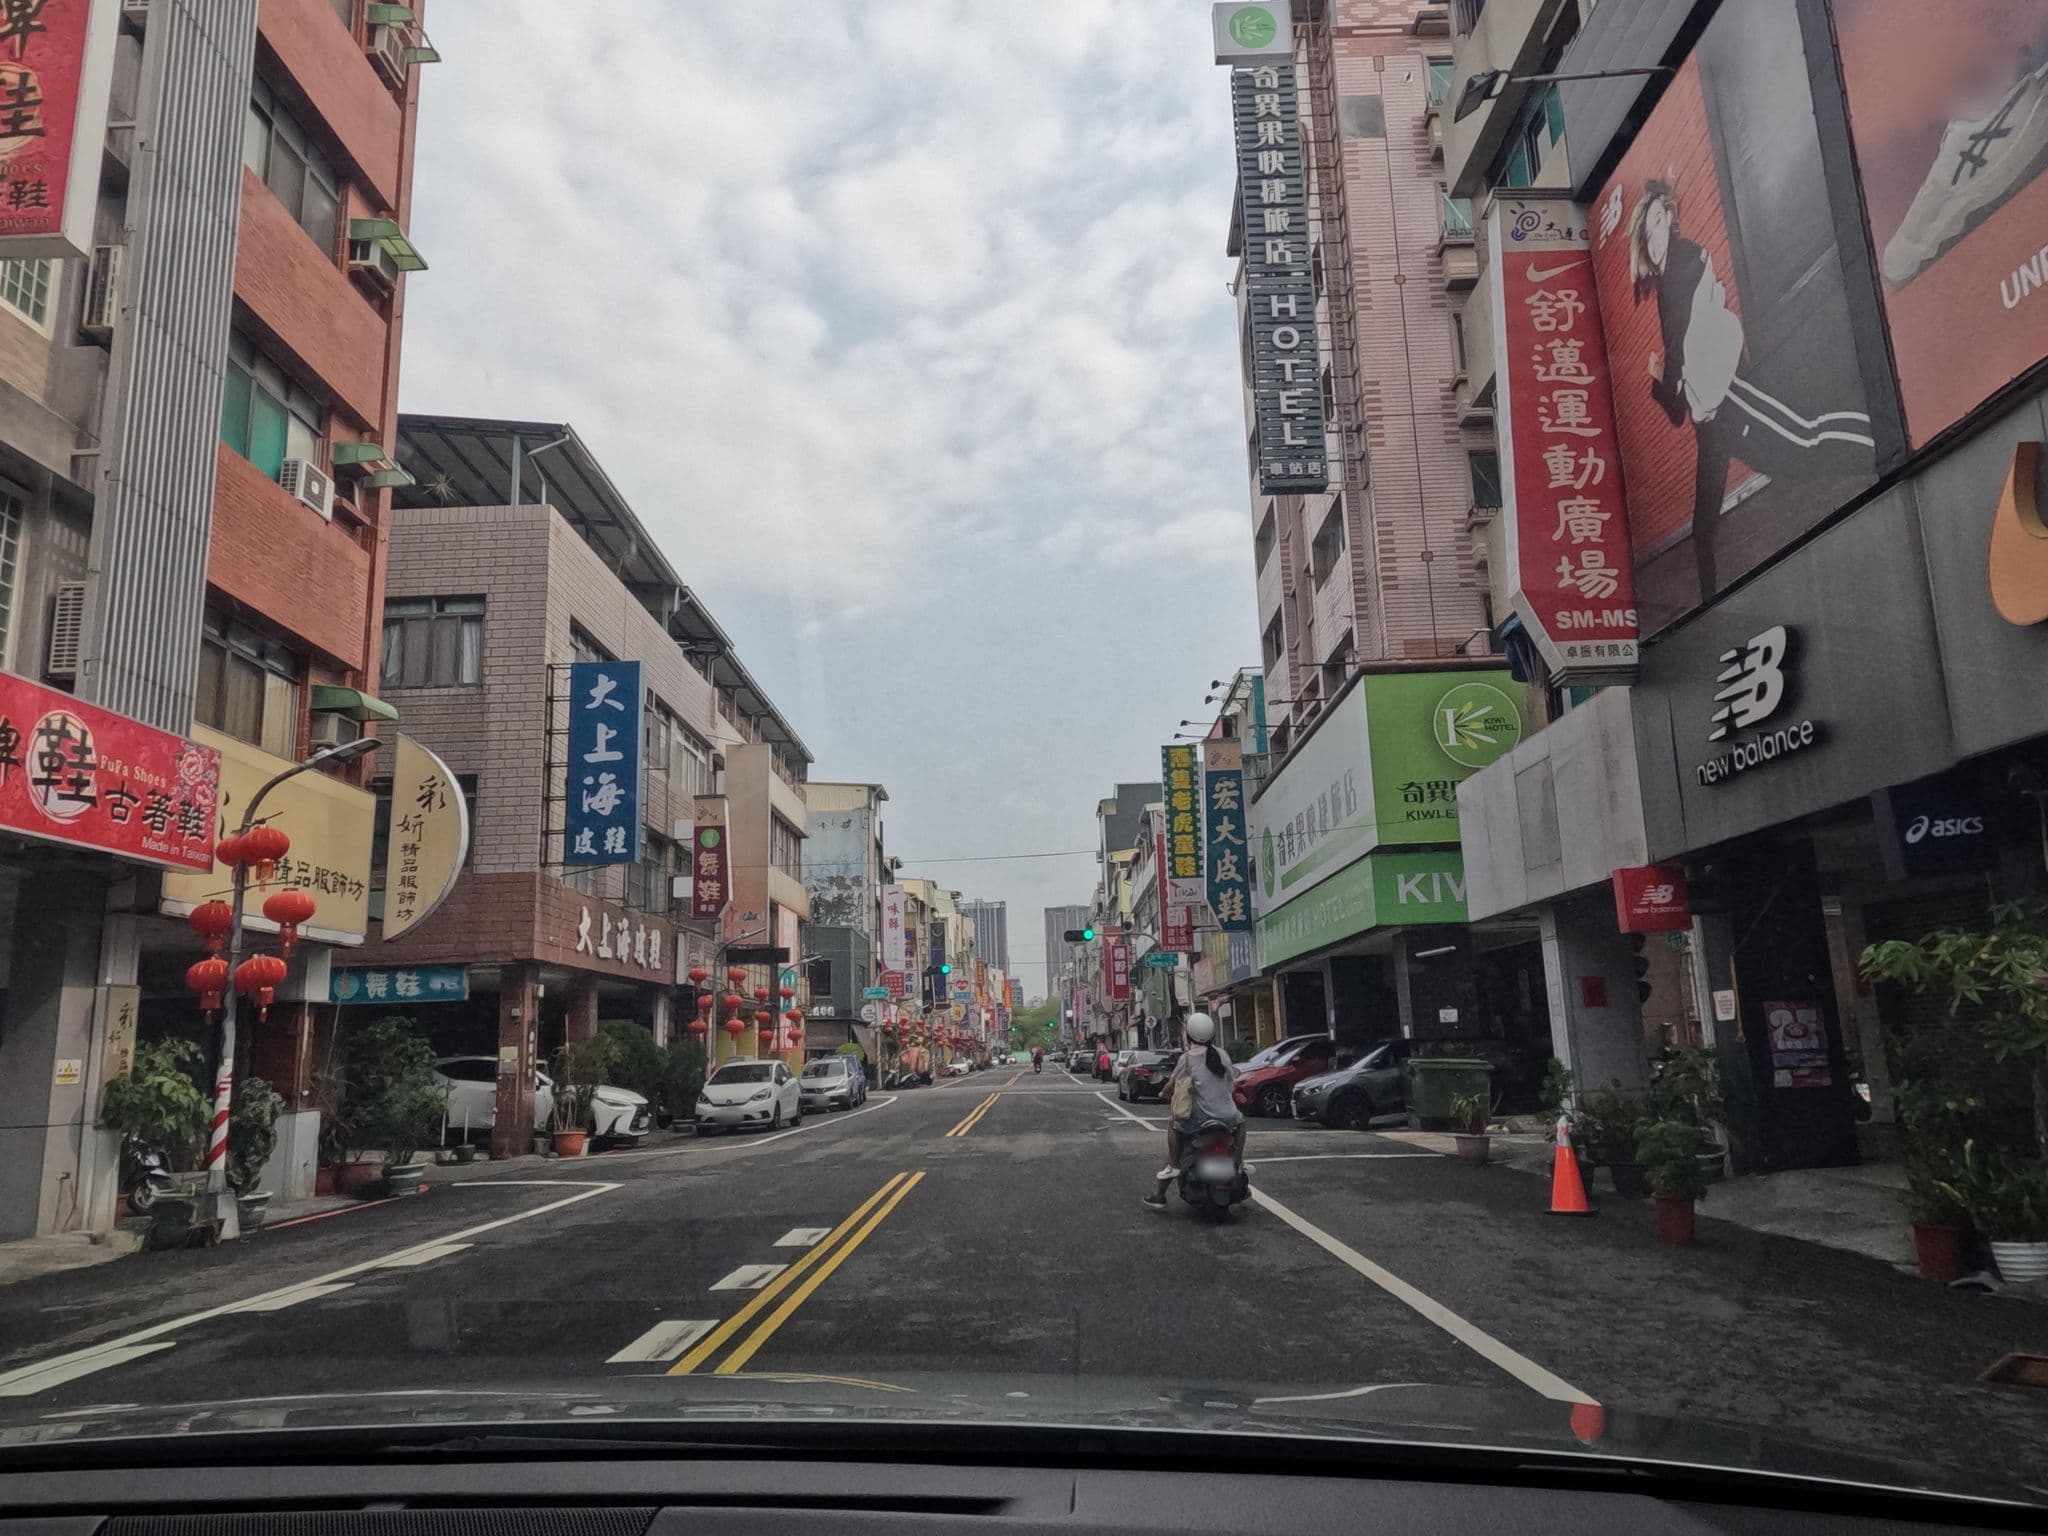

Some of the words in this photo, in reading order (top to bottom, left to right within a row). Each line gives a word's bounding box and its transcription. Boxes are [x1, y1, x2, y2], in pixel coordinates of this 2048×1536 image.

[1250, 65, 1293, 265] 奇異果快捷旅店
[1270, 294, 1308, 446] HOTEL
[1524, 289, 1620, 599] 舒邁運動廣場
[134, 765, 166, 788] Shoes
[583, 673, 626, 817] 大上海
[1696, 754, 1729, 786] new
[1732, 720, 1814, 771] balance
[142, 836, 169, 851] Made
[170, 844, 180, 855] in
[182, 849, 212, 863] Taiwan
[573, 826, 628, 855] 皮鞋
[1212, 777, 1246, 923] 宏大皮鞋
[1930, 816, 1984, 837] asics
[397, 843, 423, 922] 精品服飾坊
